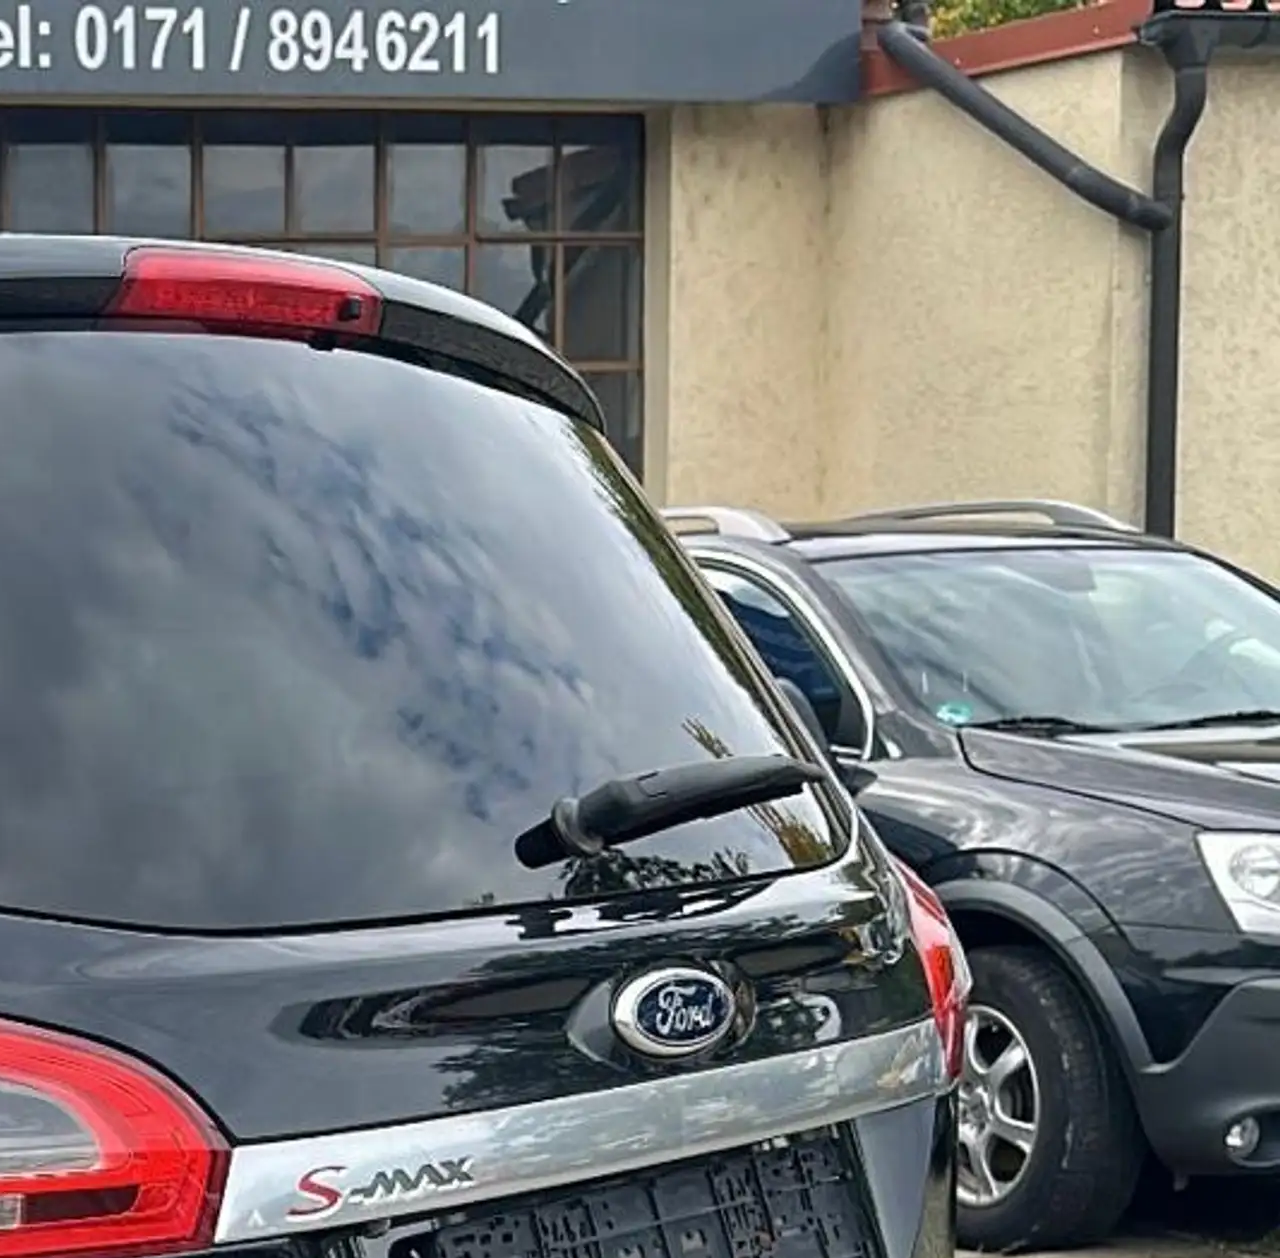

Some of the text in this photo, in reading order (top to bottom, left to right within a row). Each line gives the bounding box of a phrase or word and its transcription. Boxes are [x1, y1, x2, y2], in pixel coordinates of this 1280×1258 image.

[74, 5, 207, 71] 0171
[228, 5, 252, 73] /
[267, 8, 500, 75] 8946211
[655, 980, 717, 1036] Ford
[286, 1155, 475, 1216] S-MAX
